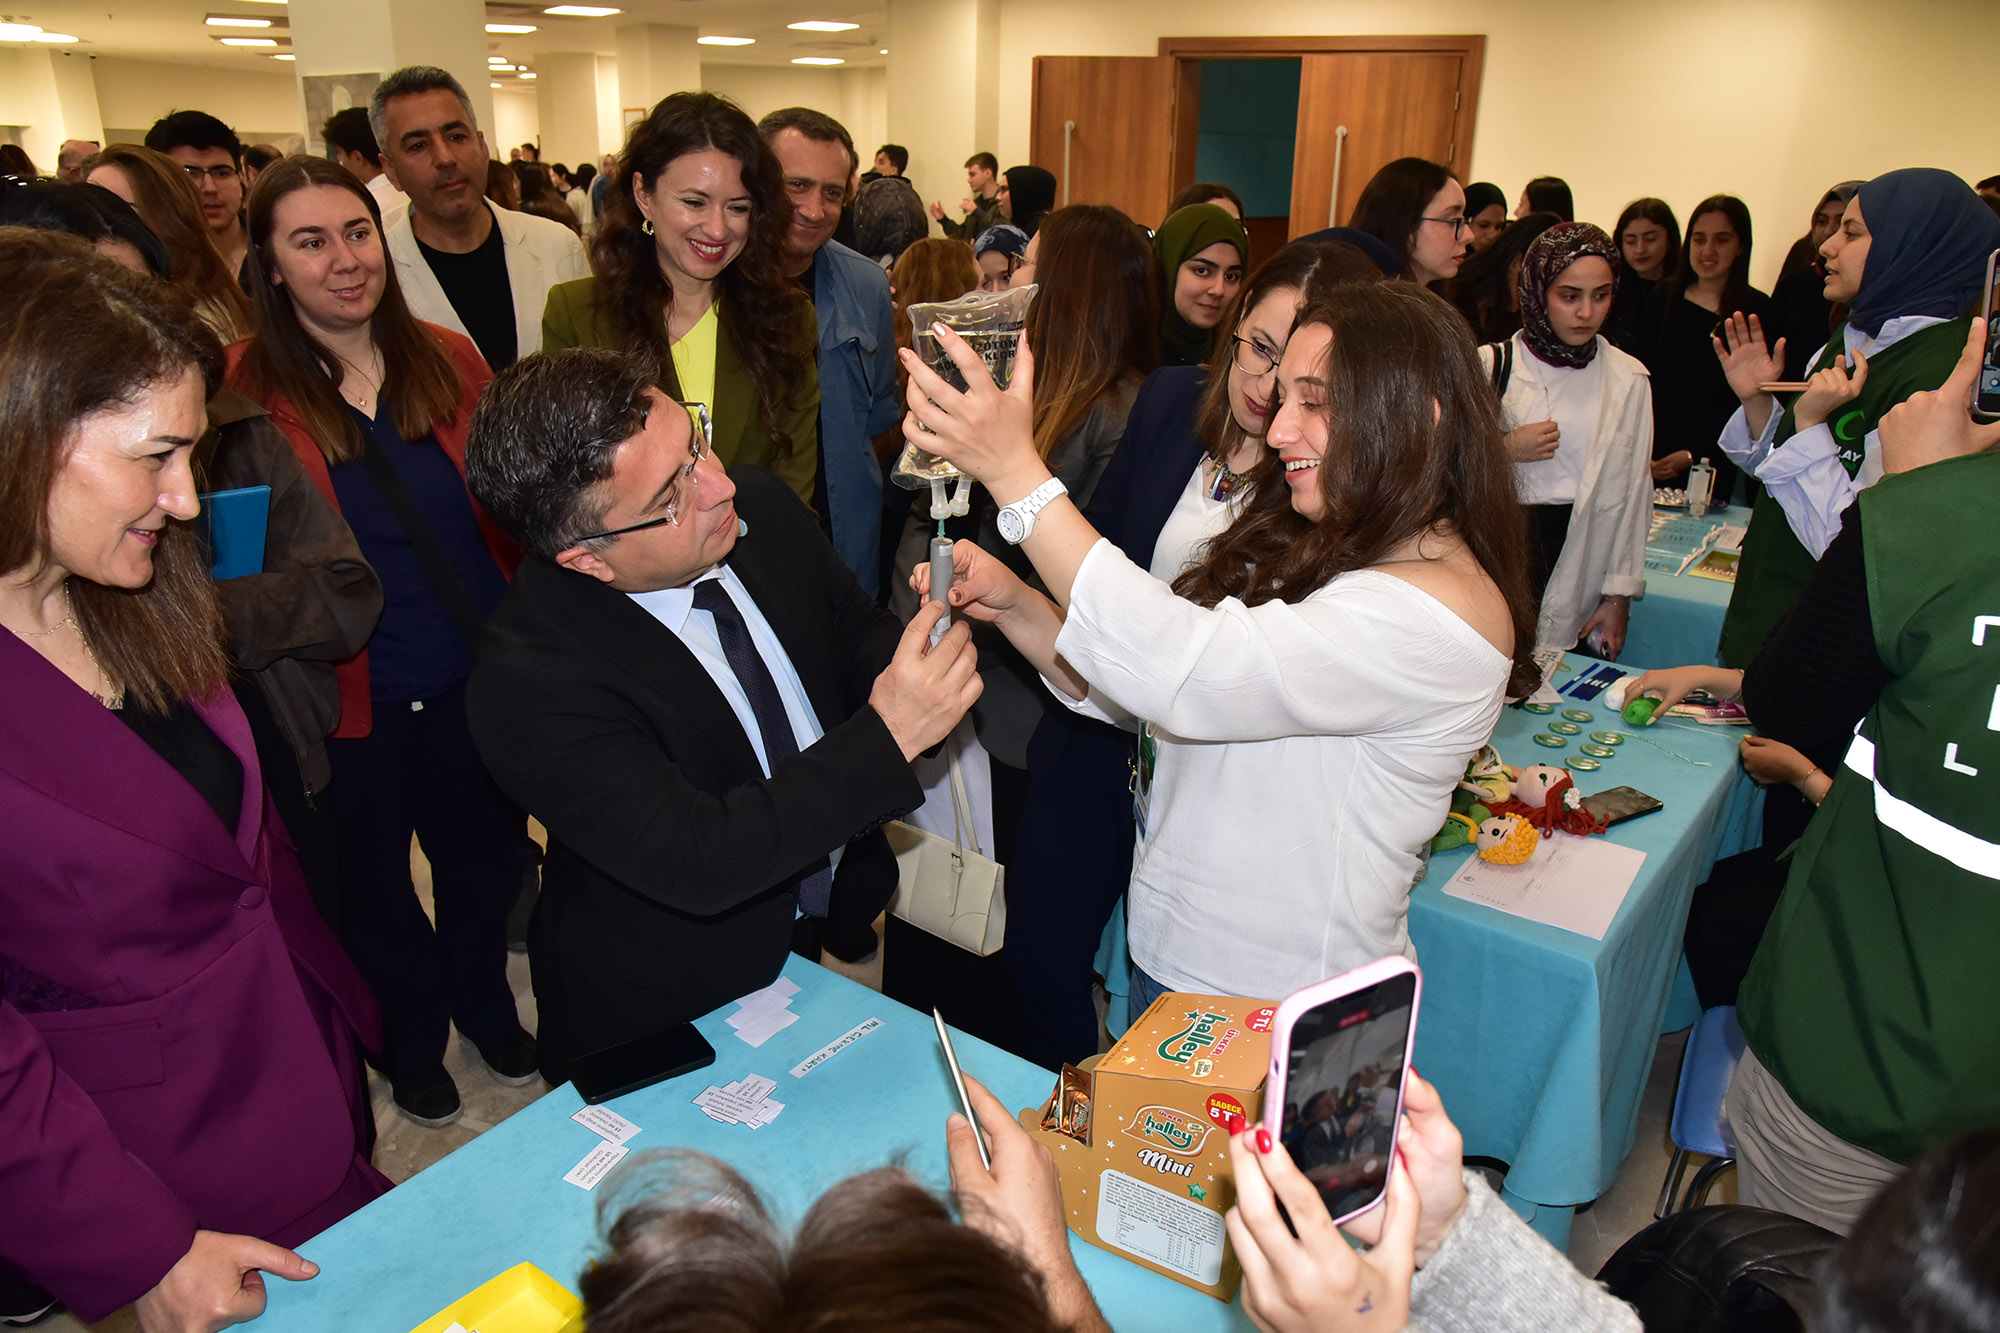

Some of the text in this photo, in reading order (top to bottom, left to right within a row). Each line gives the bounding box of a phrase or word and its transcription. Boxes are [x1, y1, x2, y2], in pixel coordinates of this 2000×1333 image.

[984, 350, 1016, 361] KLOR
[1260, 1008, 1274, 1016] 5
[861, 1020, 879, 1030] ML
[1158, 1012, 1228, 1063] halley
[1212, 1028, 1240, 1055] ÜLKER
[1210, 1098, 1242, 1114] SADECE
[1209, 1107, 1236, 1122] 5 T
[1144, 1115, 1193, 1149] halley
[1137, 1149, 1194, 1177] Mini
